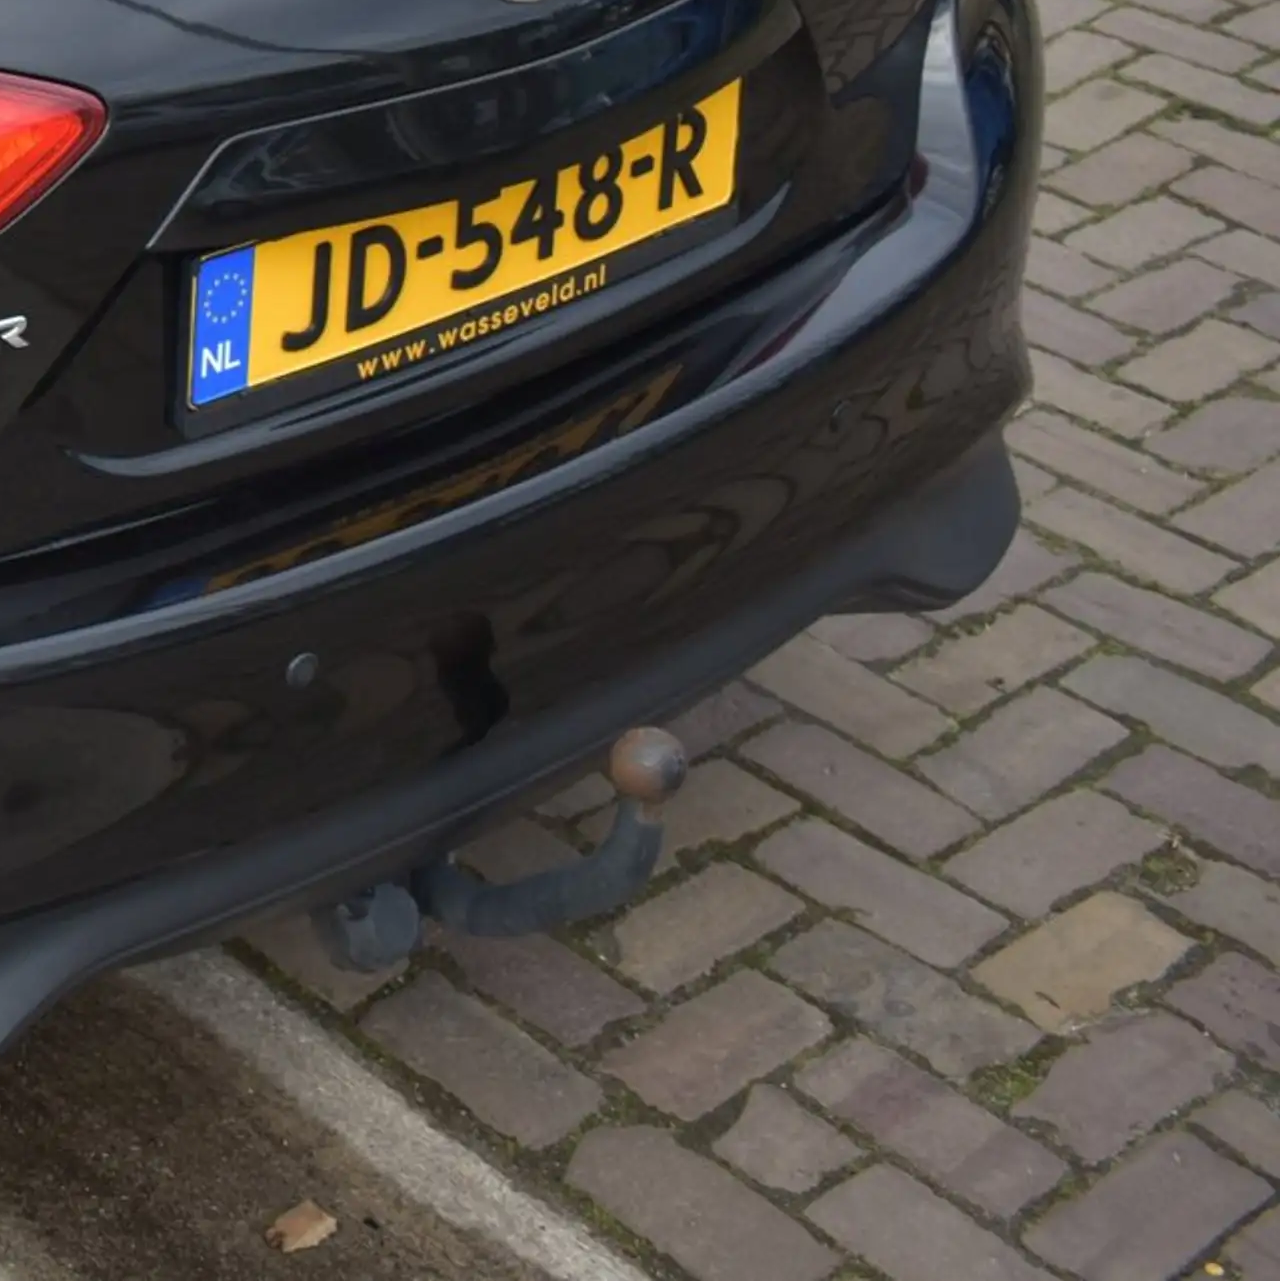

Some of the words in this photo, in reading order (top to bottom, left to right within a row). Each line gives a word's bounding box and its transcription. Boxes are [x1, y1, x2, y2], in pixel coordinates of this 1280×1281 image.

[280, 106, 707, 352] JD-548-R
[201, 338, 242, 379] NL
[356, 264, 607, 380] www.wasseveld.nl
